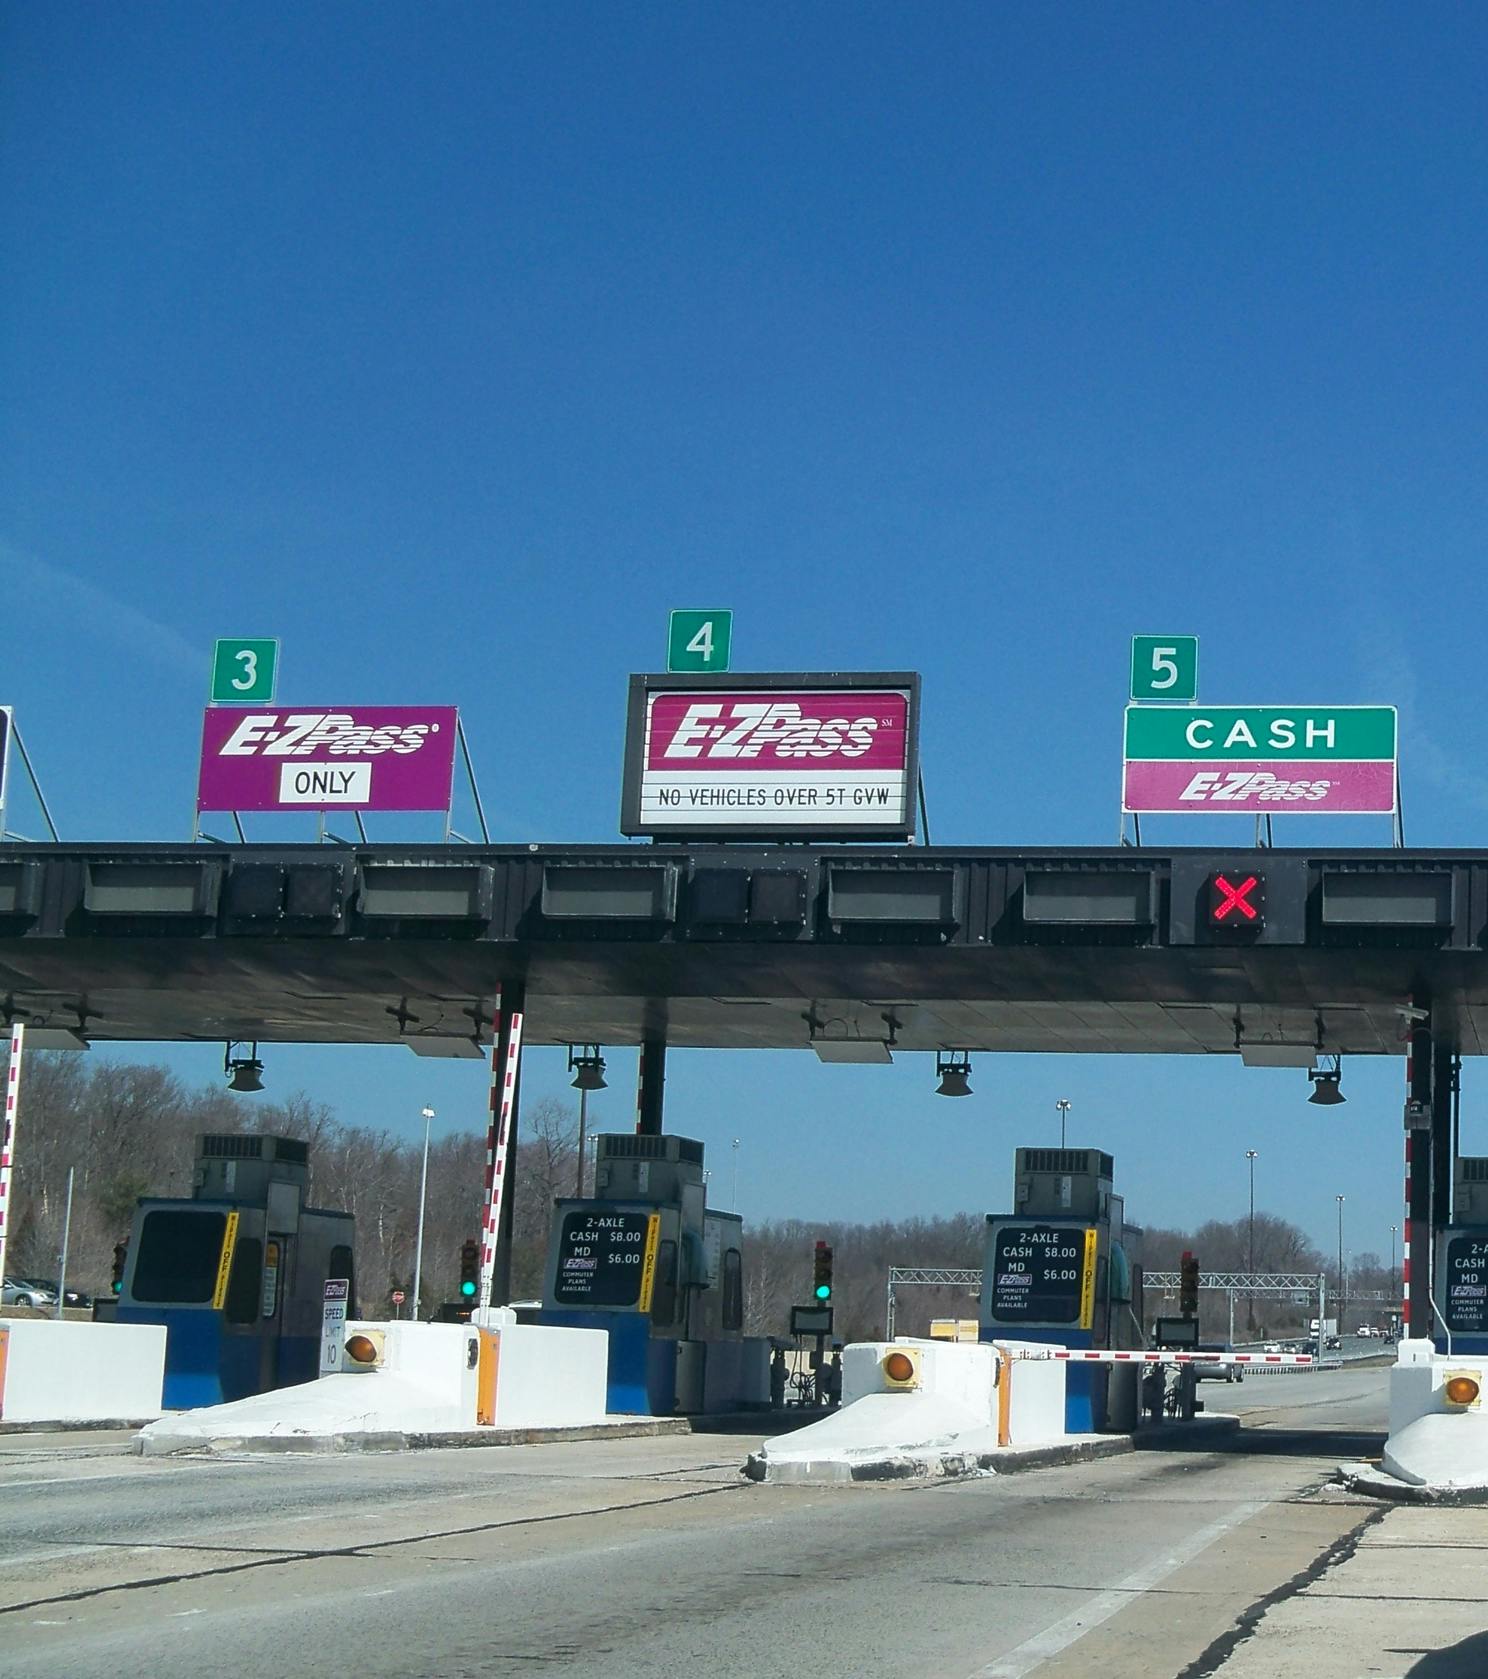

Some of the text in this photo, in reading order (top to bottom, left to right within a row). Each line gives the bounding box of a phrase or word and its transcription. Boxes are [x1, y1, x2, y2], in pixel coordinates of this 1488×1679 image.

[686, 621, 714, 661] 4
[231, 650, 258, 690] 3
[1150, 647, 1178, 689] 5
[1185, 719, 1335, 749] CASH
[295, 771, 356, 794] ONLY
[659, 788, 889, 806] NO VEHICLES OVER 5T GVW
[587, 1218, 625, 1227] 2-AXLE
[570, 1232, 640, 1242] CASH $8.00
[1020, 1233, 1059, 1243] 2-AXLE
[574, 1247, 591, 1256] MD
[1003, 1247, 1076, 1258] CASH $8.00
[608, 1254, 640, 1263] $6.00
[1455, 1258, 1485, 1268] CASH
[1008, 1263, 1025, 1272] MD
[1044, 1269, 1076, 1280] $6.00
[1461, 1274, 1478, 1283] MD
[325, 1308, 344, 1320] SPEED
[327, 1344, 337, 1364] 10
